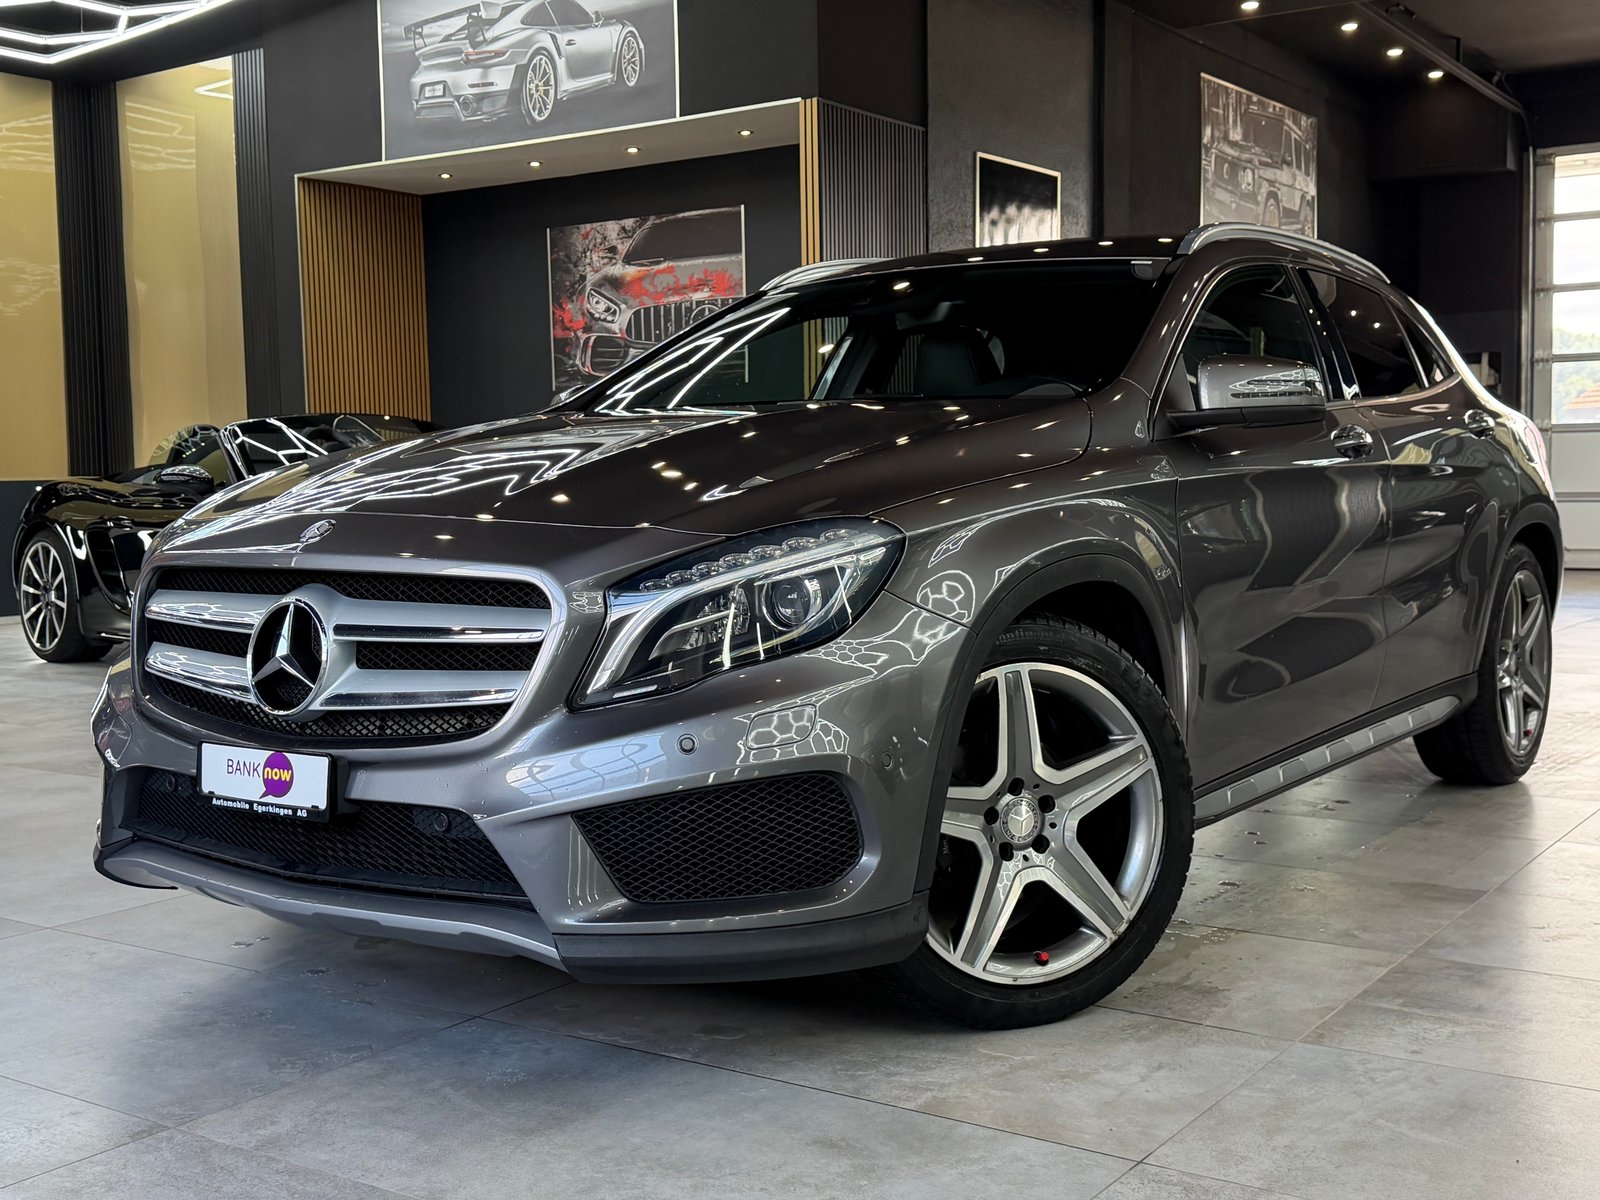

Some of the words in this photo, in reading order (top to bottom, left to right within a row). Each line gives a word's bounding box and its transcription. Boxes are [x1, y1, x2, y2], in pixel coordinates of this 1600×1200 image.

[227, 758, 261, 778] BANK
[264, 767, 292, 782] now
[212, 798, 250, 810] Automobile
[253, 803, 293, 816] Egerkingen
[296, 808, 308, 817] AG
